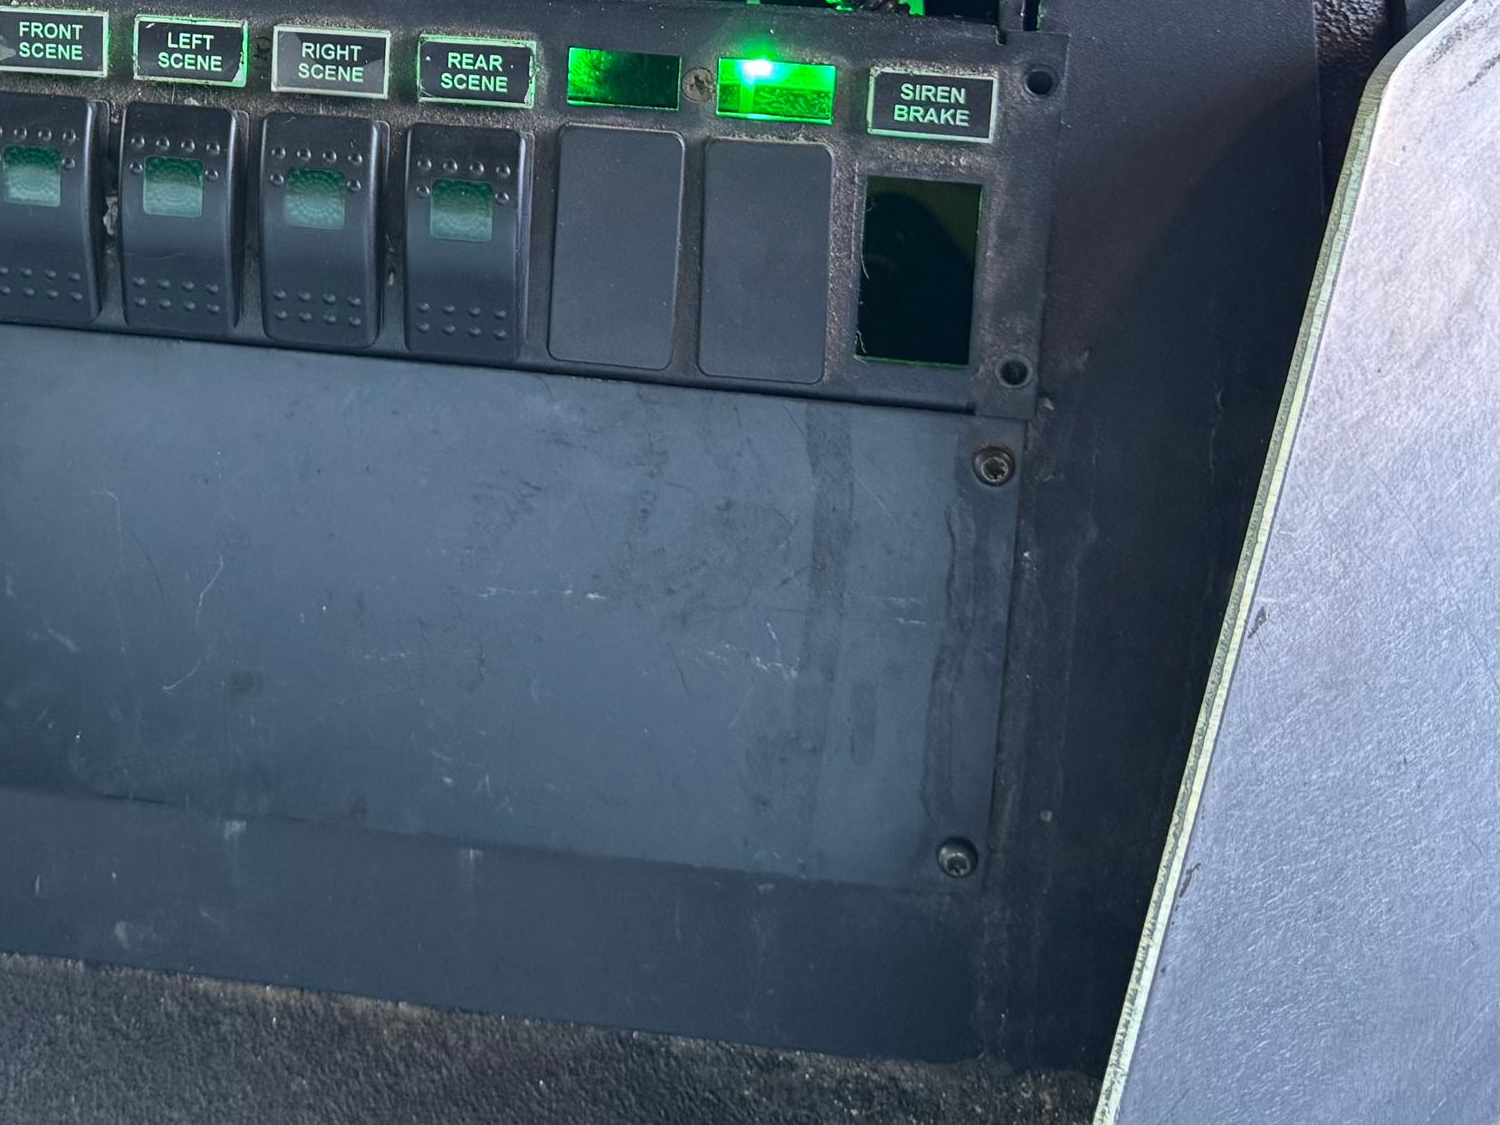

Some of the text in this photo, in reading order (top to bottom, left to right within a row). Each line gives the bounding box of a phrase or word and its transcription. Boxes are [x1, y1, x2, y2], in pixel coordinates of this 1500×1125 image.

[19, 21, 84, 42] FRONT
[166, 31, 213, 51] LEFT
[19, 41, 84, 62] SCENE
[300, 42, 362, 62] RIGHT
[447, 51, 504, 72] REAR
[157, 52, 223, 73] SCENE
[298, 62, 364, 83] SCENE
[440, 72, 508, 93] SCENE
[899, 82, 966, 105] SIREN
[893, 104, 970, 127] BRAKE
